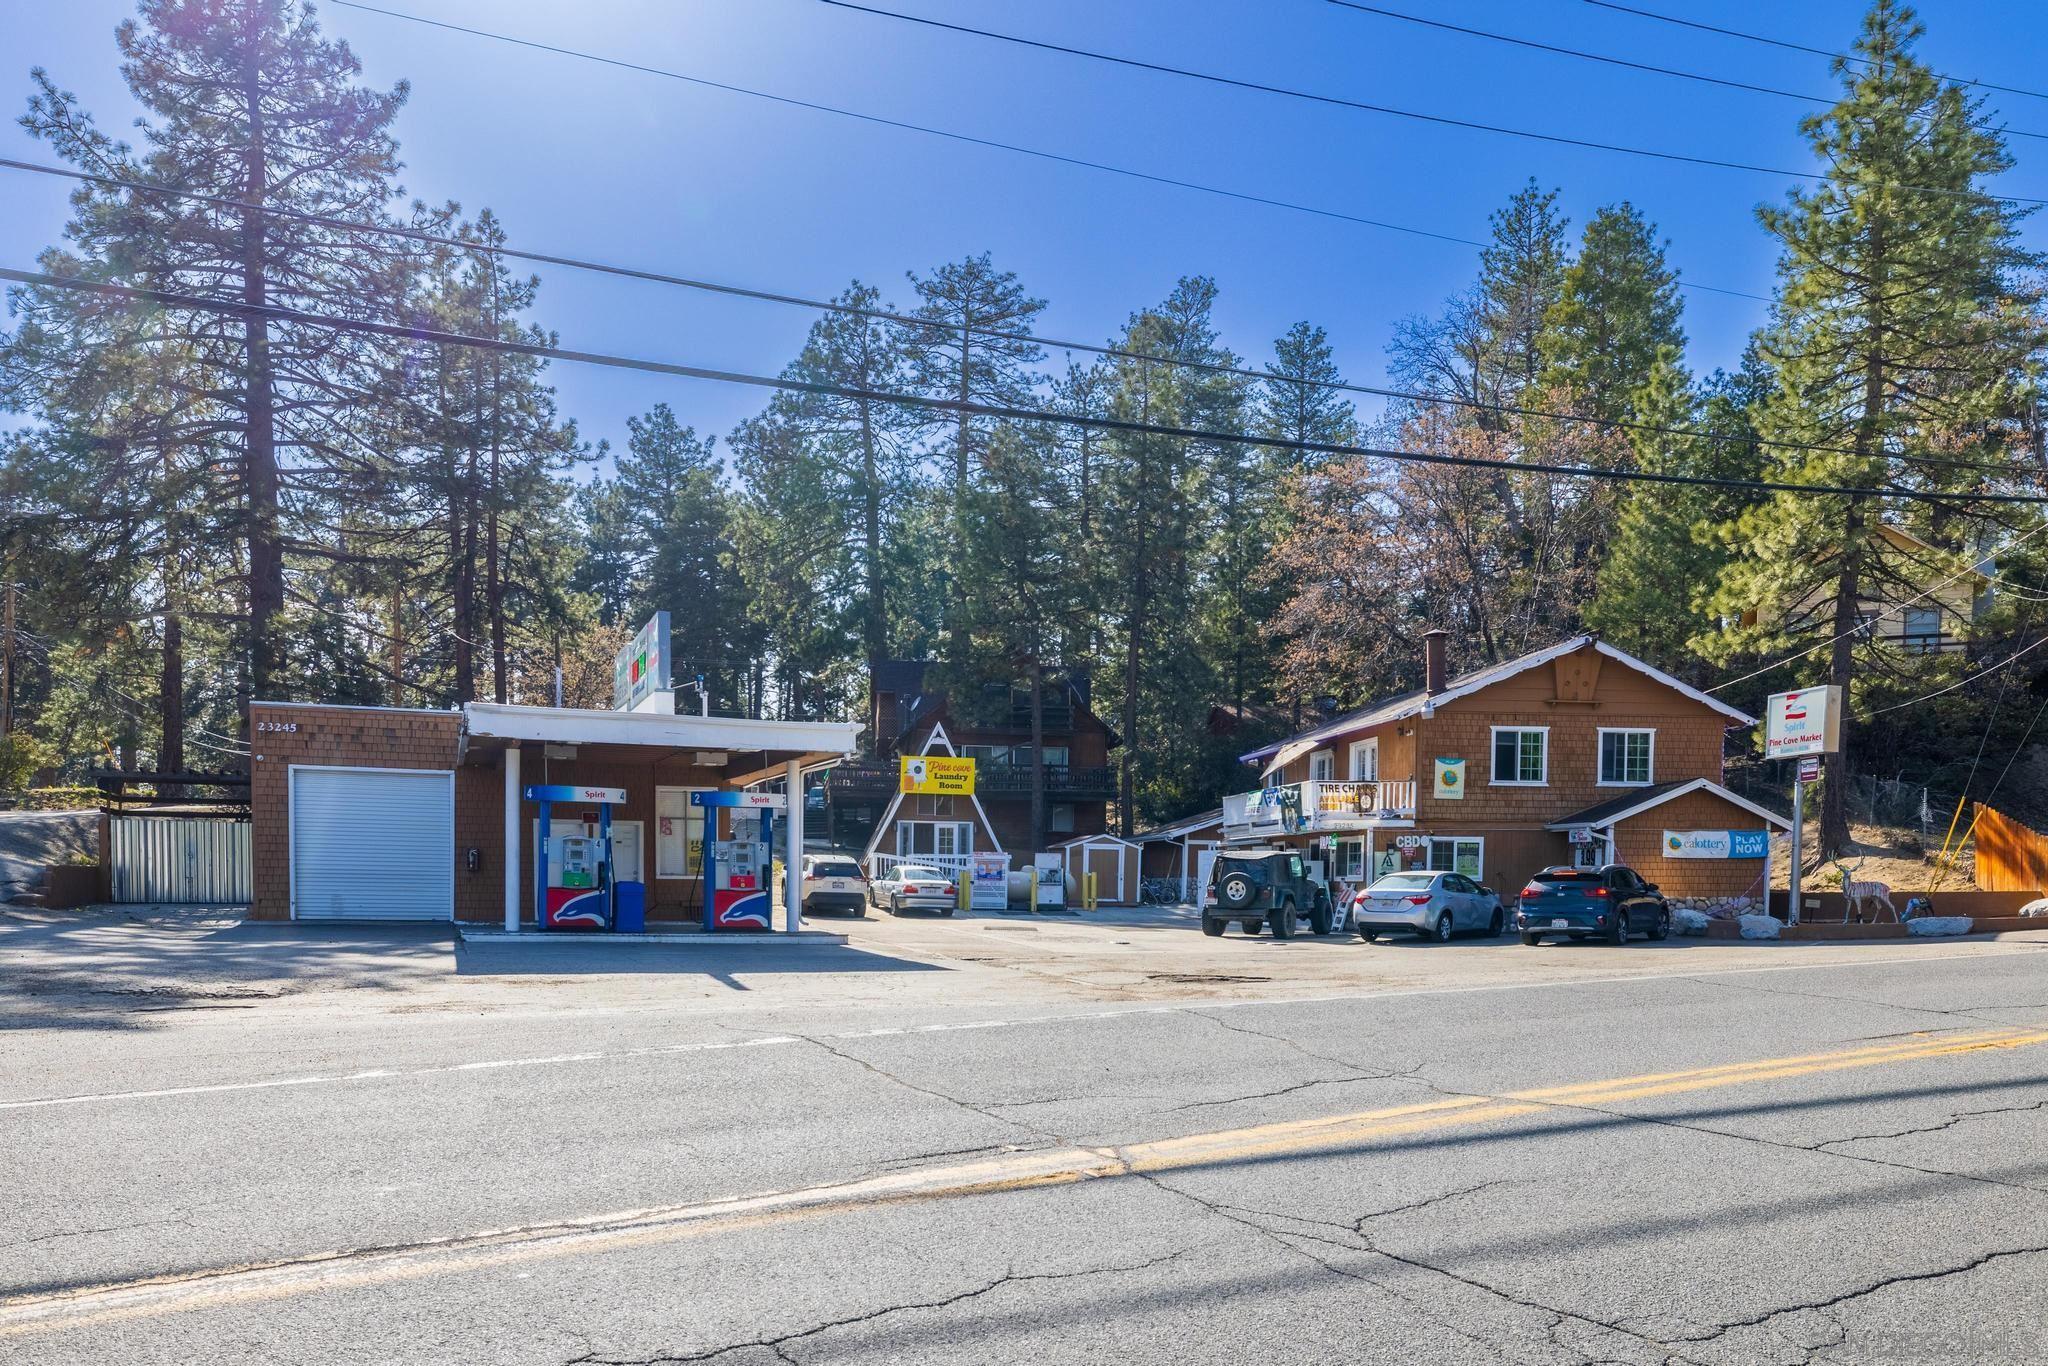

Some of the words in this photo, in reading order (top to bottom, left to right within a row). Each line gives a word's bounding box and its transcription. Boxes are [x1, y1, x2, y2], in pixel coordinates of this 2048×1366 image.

[258, 722, 297, 732] 23245
[1784, 721, 1806, 733] Spirit
[1769, 738, 1782, 747] Pine
[1783, 737, 1798, 745] Cove
[1800, 733, 1822, 743] Market
[928, 761, 951, 773] Pine
[934, 773, 968, 781] Laundry
[939, 782, 963, 790] Room
[1319, 784, 1340, 793] TIRE
[1342, 784, 1378, 793] CHAINS
[526, 788, 532, 799] 4
[584, 790, 606, 800] Spirit
[620, 791, 625, 801] 4
[694, 793, 700, 804] 2
[750, 796, 770, 805] Spirit
[595, 840, 601, 848] 4
[1396, 835, 1420, 848] CBD
[1684, 837, 1727, 850] calottery
[1735, 835, 1762, 844] PLAY
[759, 843, 764, 852] 2
[1736, 844, 1763, 854] NOW
